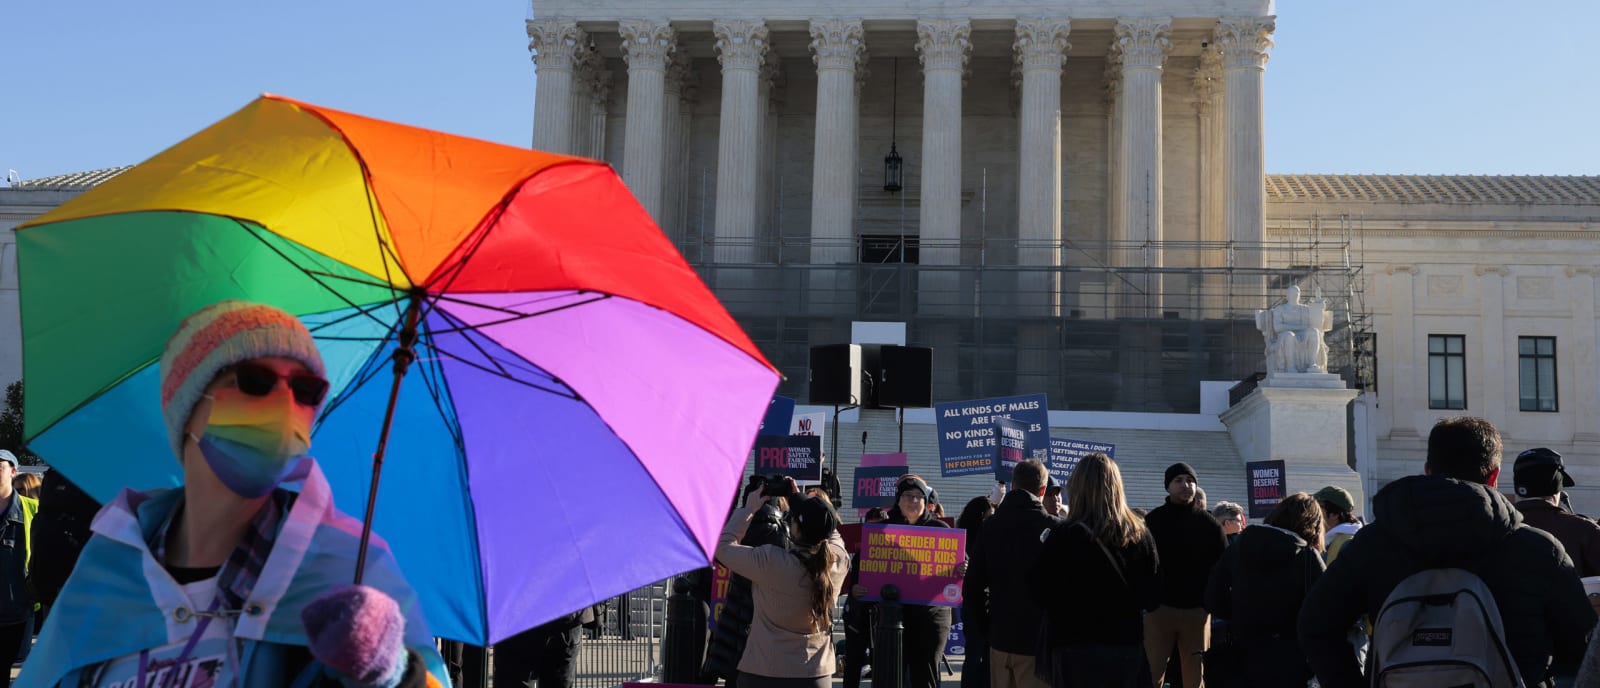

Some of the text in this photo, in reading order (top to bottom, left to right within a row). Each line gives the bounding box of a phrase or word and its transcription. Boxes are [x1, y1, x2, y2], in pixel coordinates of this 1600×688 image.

[944, 401, 1039, 417] ALL KINDS OF MALES
[798, 419, 811, 431] NO
[971, 416, 988, 425] ARE
[946, 428, 993, 440] NO KINDS
[1001, 426, 1024, 440] WOMEN
[966, 440, 984, 448] ARE
[1001, 438, 1024, 450] DESERVE
[760, 447, 788, 468] PRO
[945, 459, 991, 469] INFORMED
[1253, 469, 1279, 478] WOMEN
[858, 477, 880, 496] PRO
[1253, 478, 1280, 487] DESERVE
[869, 533, 958, 550] MOST GENDER NON
[869, 547, 956, 564] CONFORMING KIDS
[860, 560, 888, 573] GROW
[890, 561, 903, 574] UP
[906, 562, 918, 574] TO
[921, 564, 932, 576] BE
